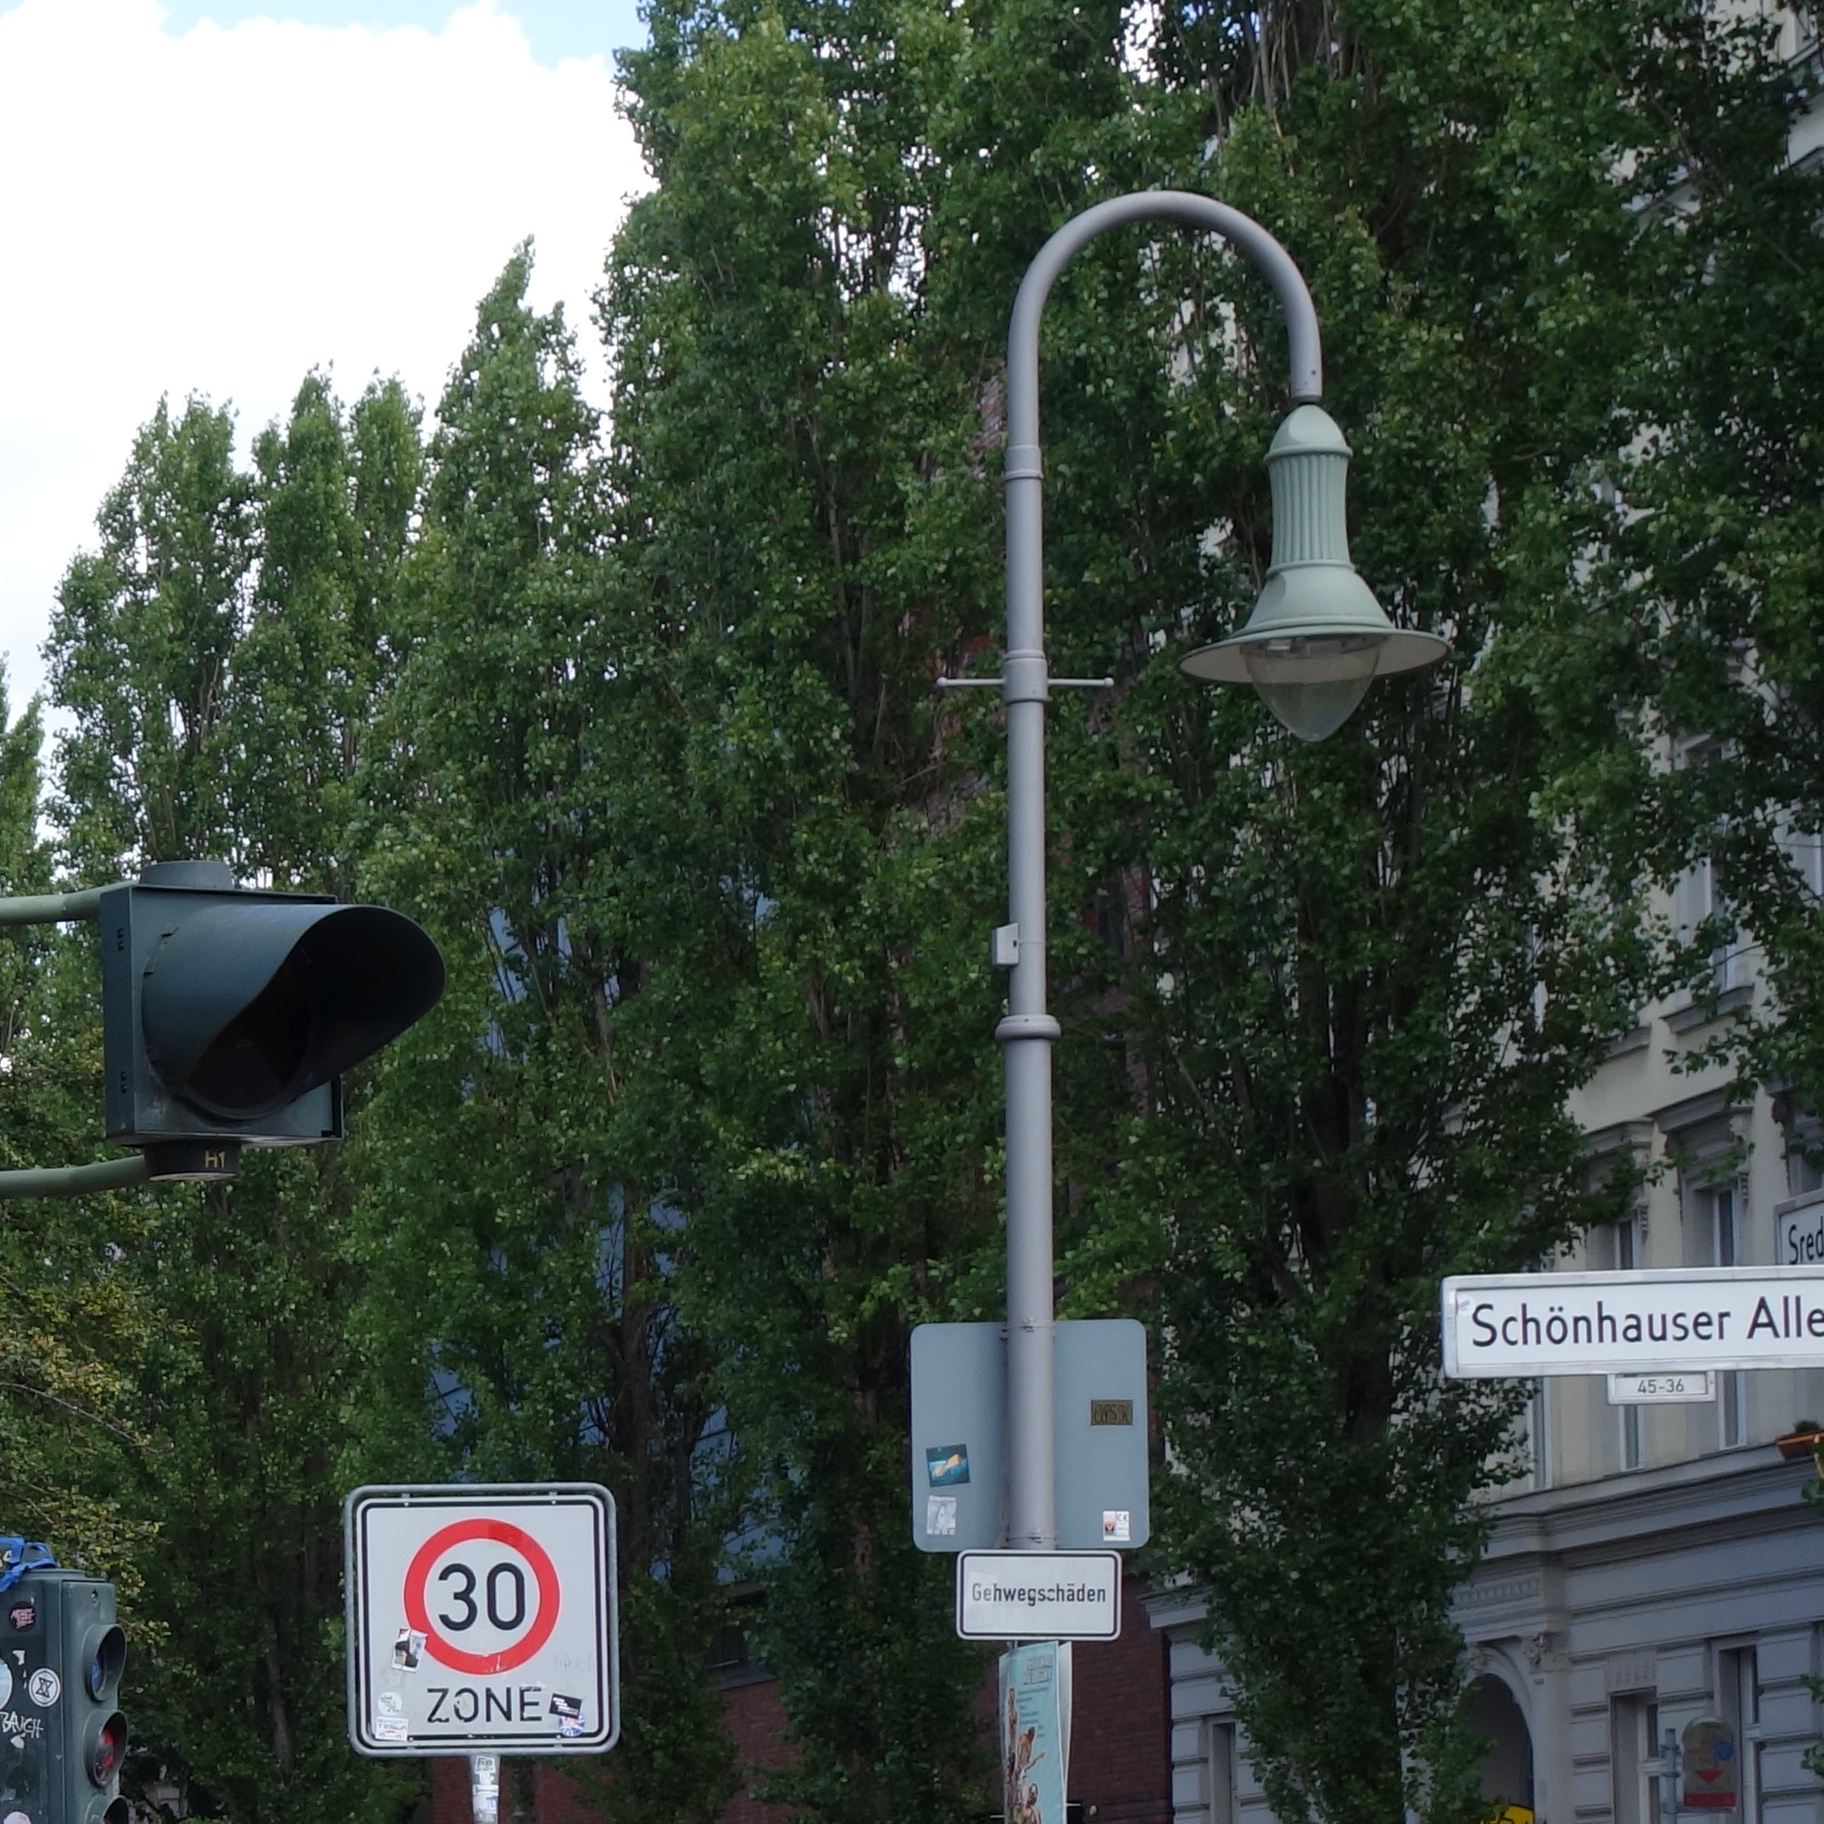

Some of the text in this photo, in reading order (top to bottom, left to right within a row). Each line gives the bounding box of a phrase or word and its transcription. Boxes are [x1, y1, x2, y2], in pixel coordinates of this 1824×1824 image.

[205, 1150, 225, 1168] H1
[1472, 1301, 1731, 1348] Schönhauser
[1637, 1379, 1685, 1395] 45-36
[437, 1562, 526, 1631] 30
[972, 1582, 1106, 1607] Gehwegschäden
[426, 1685, 543, 1724] ZONE
